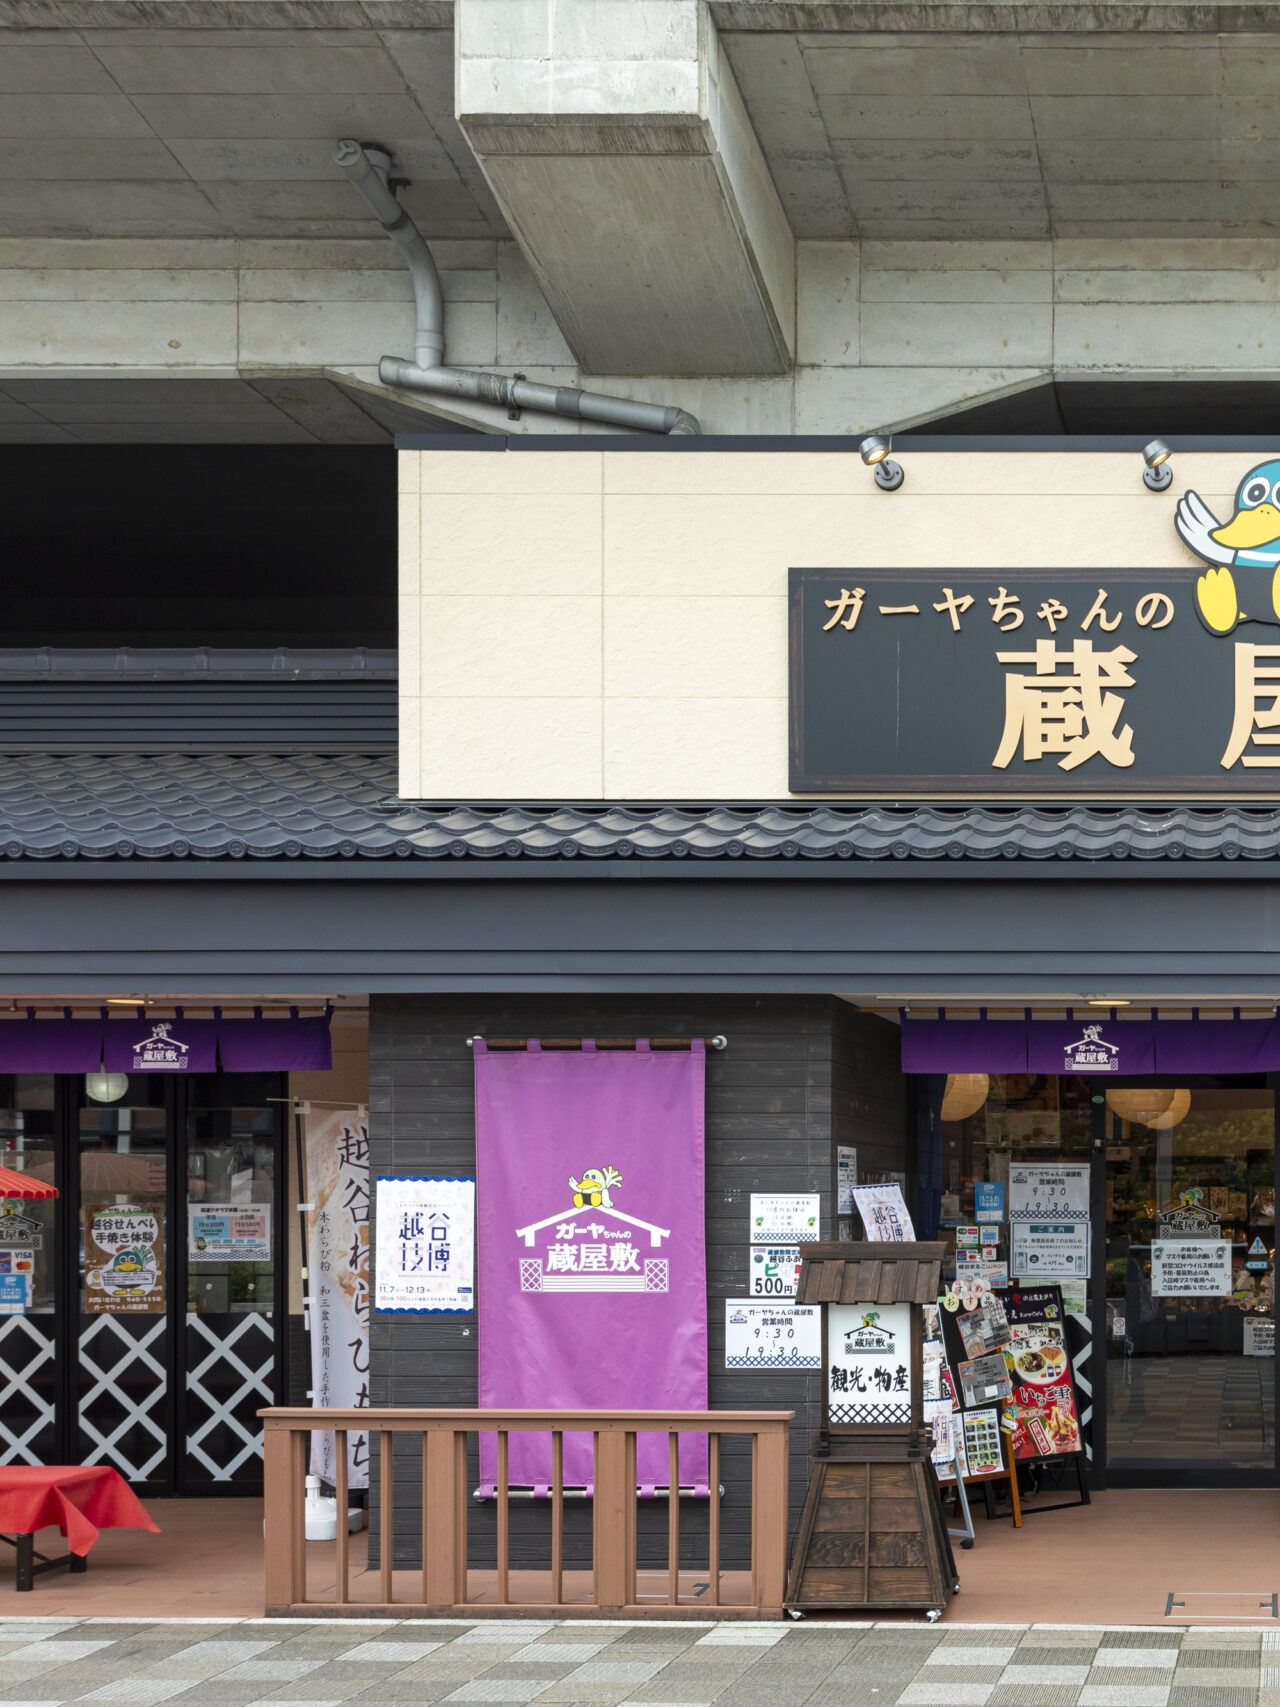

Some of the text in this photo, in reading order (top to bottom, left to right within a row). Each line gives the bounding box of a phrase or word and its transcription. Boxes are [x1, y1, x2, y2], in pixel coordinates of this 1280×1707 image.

[822, 587, 1175, 632] ガーヤちゃんの
[143, 1050, 177, 1061] 蔵屋敷
[1075, 1052, 1108, 1063] 蔵屋敷
[399, 1212, 451, 1241] 越谷
[556, 1222, 632, 1240] ガーヤちゃんの
[1172, 1220, 1209, 1231] 蔵屋敷
[95, 1232, 154, 1244] 手焼き体験
[545, 1242, 641, 1272] 蔵屋敷
[755, 1277, 793, 1294] 500円
[761, 1318, 793, 1326] 営業時間
[854, 1338, 885, 1347] 蔵屋敷
[831, 1364, 909, 1392] 観光・物産
